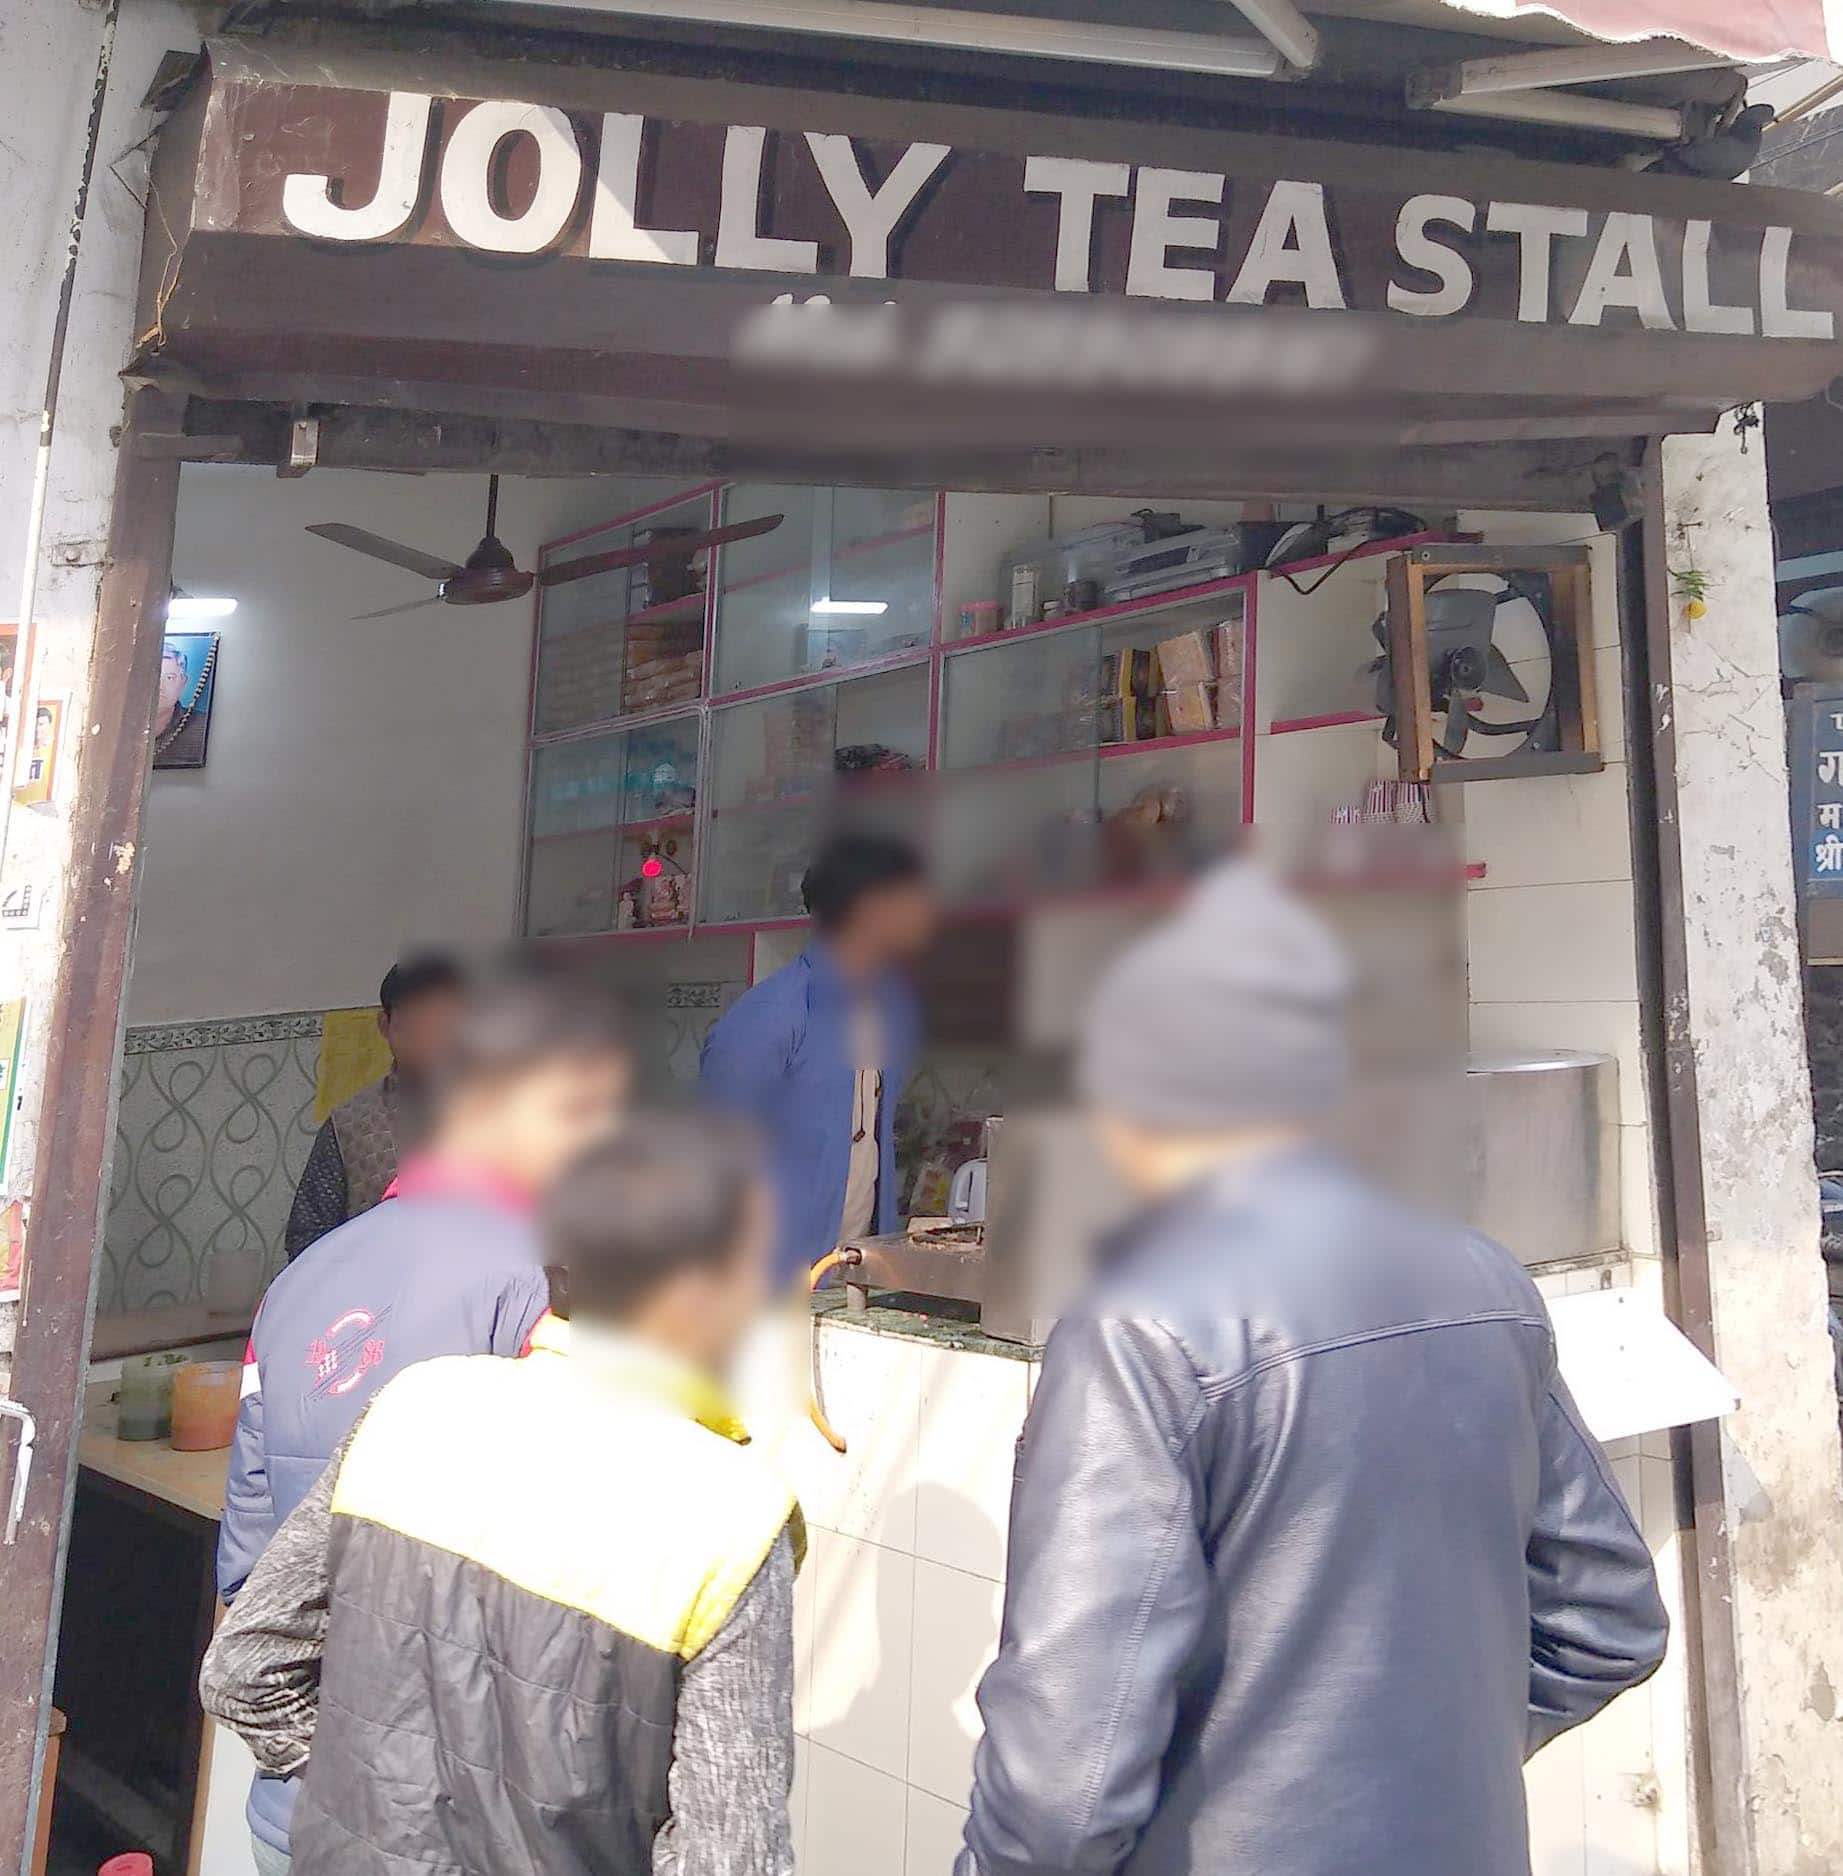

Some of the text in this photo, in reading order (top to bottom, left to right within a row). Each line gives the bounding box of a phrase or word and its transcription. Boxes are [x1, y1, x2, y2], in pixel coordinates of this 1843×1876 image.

[283, 91, 1835, 340] JOLLY TEA STALL
